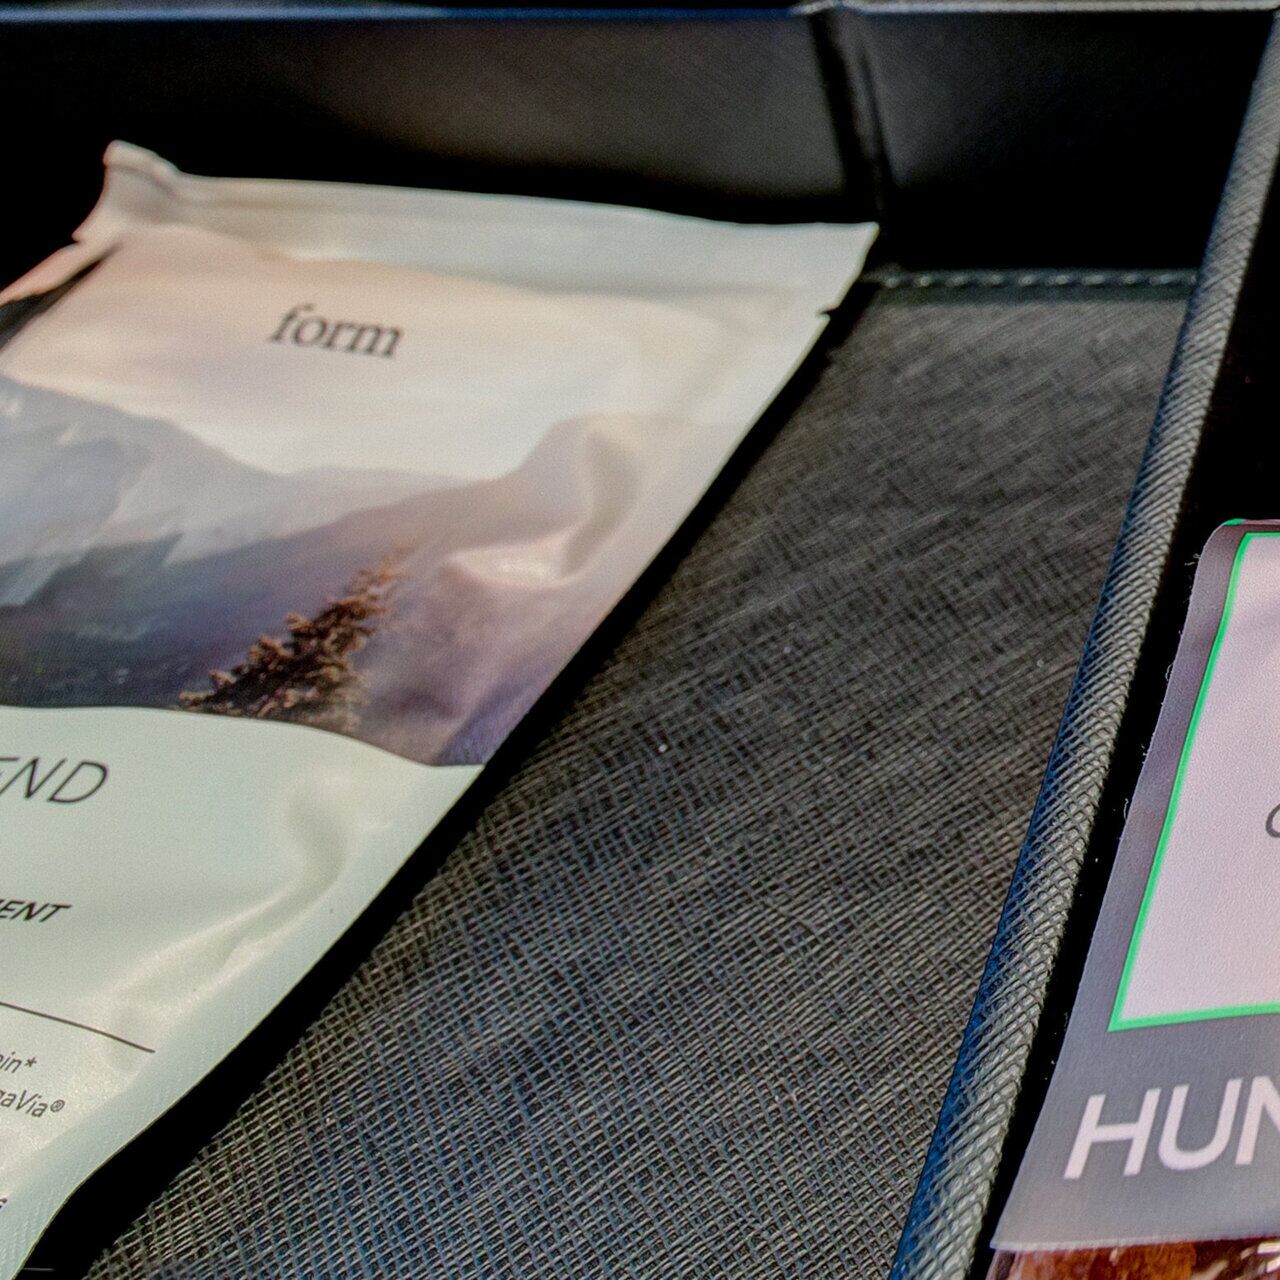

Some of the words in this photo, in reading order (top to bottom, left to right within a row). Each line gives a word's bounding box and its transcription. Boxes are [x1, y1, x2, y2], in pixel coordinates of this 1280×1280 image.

[268, 303, 403, 359] form
[0, 757, 110, 804] ND
[0, 898, 73, 923] ENT
